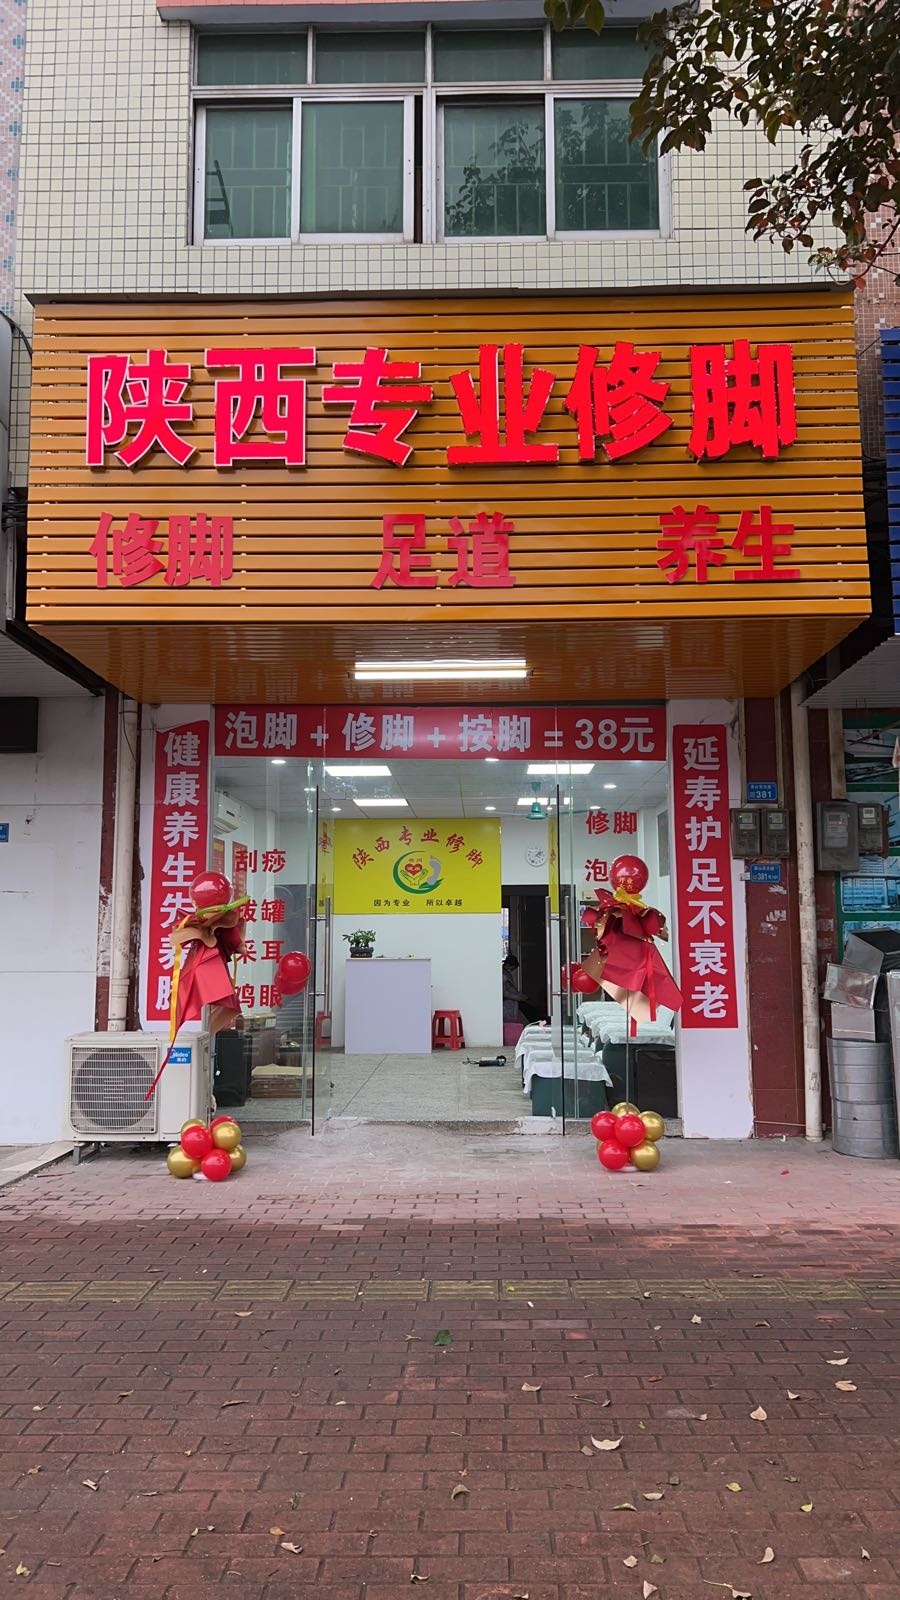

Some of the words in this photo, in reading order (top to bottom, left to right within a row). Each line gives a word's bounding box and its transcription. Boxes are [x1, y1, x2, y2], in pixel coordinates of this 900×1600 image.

[85, 339, 797, 469] 陕西专业修脚
[91, 512, 234, 588] 修脚
[371, 511, 516, 588] 足道
[657, 505, 801, 584] 养生
[352, 825, 484, 870] 陕西专业修脚
[585, 811, 637, 834] 修脚
[235, 849, 286, 873] 刮痧
[682, 735, 729, 1019] 延寿护足不衰老
